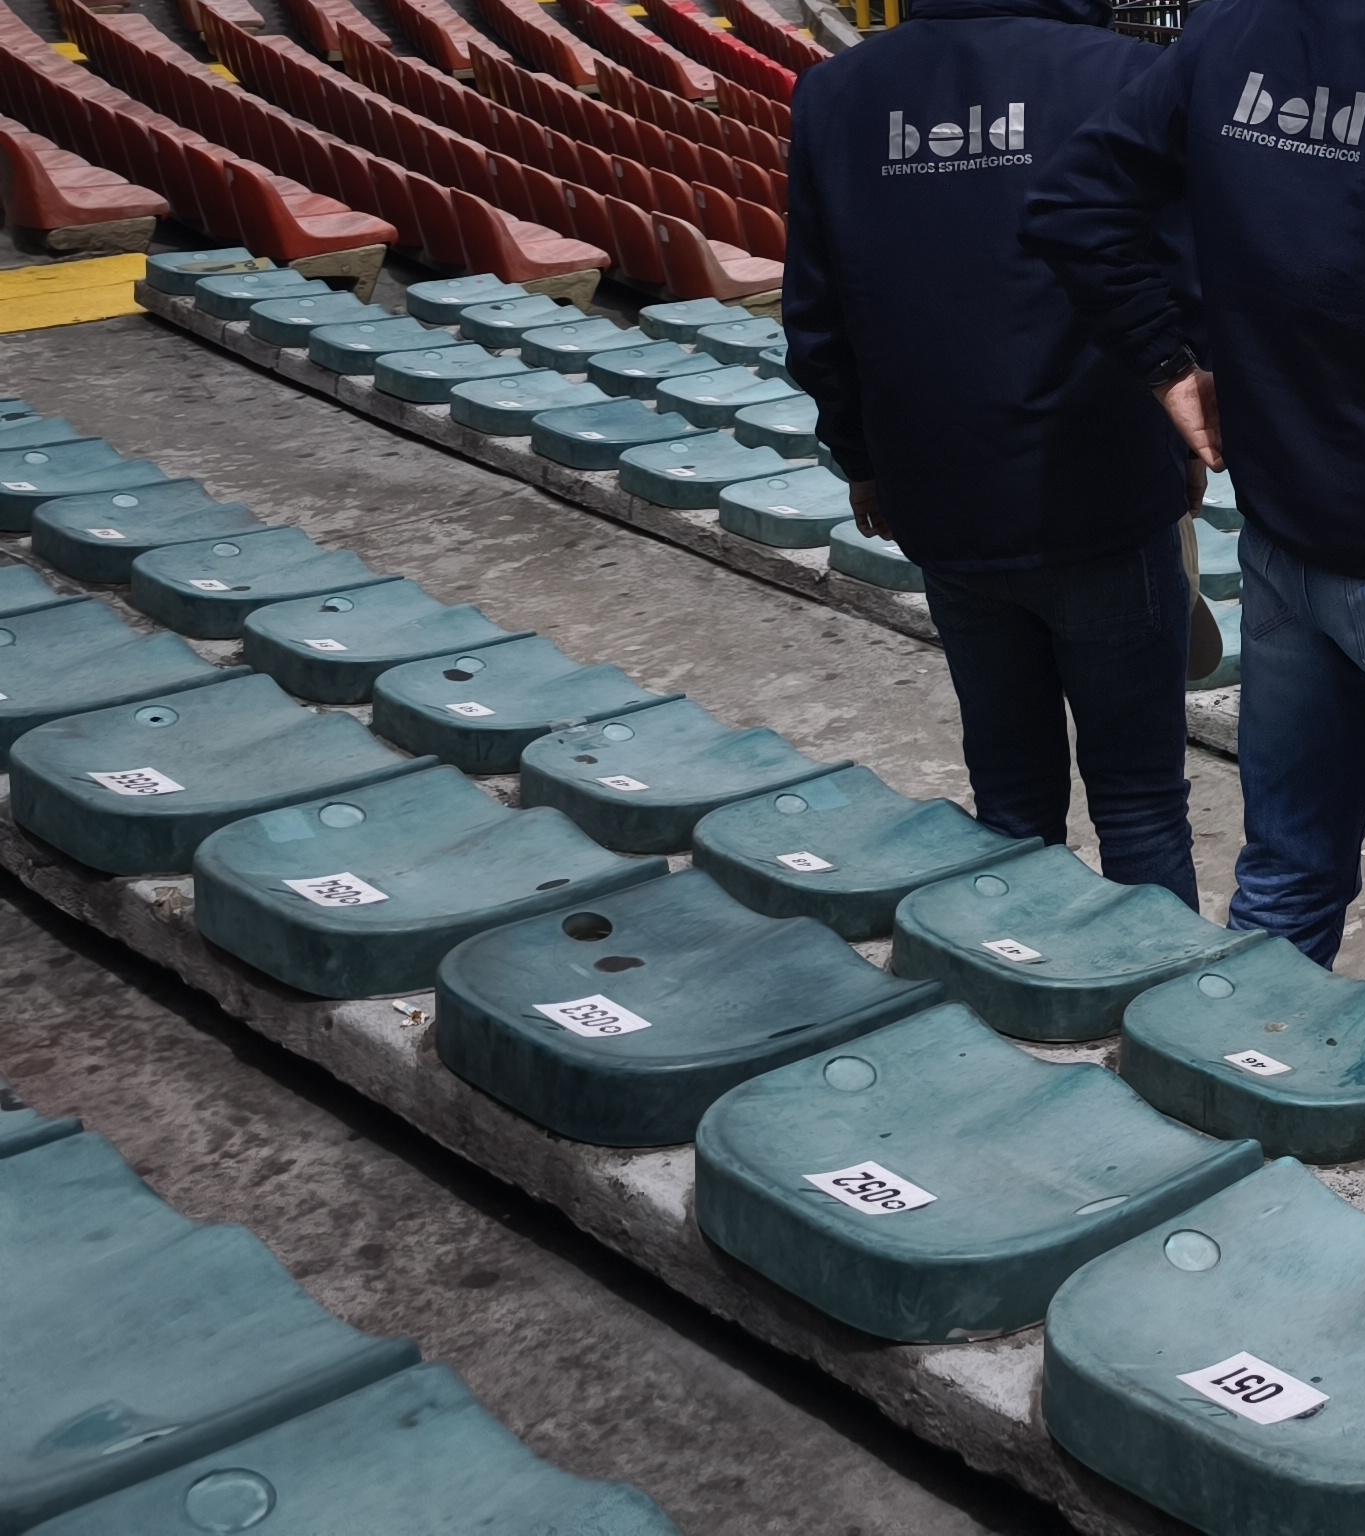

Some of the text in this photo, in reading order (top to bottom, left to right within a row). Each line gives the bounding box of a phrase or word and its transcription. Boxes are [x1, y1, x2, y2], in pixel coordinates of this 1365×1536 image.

[889, 102, 1025, 160] bold
[1221, 124, 1361, 163] EVENTOS ESTRATÉGICOS
[881, 154, 1033, 176] EVENTOS ESTRATÉGICOS
[1240, 1057, 1268, 1069] 46
[1209, 1366, 1285, 1404] 051
